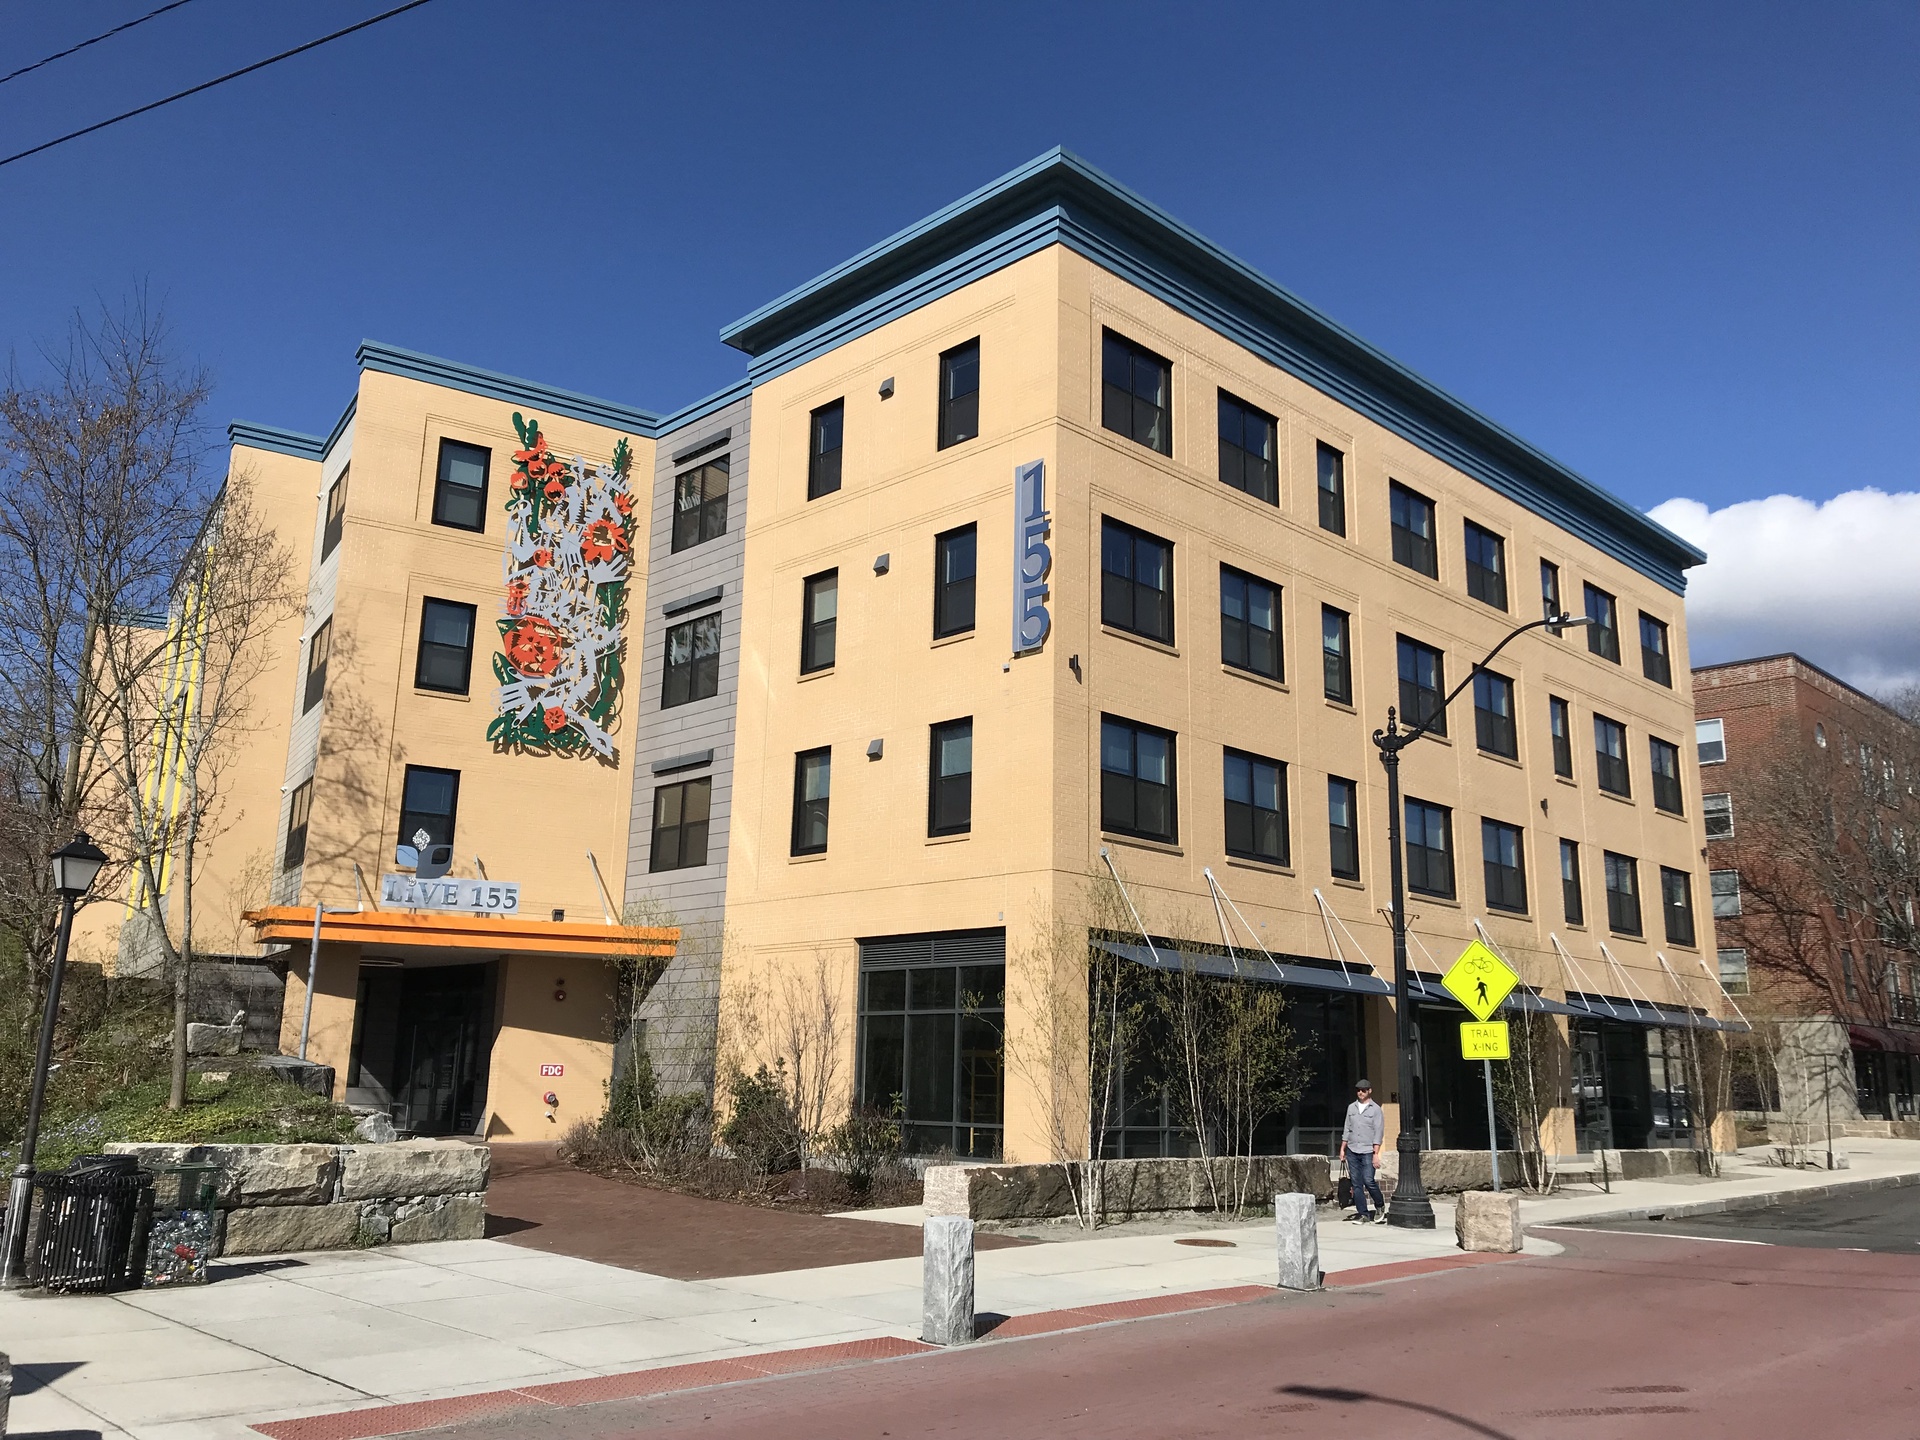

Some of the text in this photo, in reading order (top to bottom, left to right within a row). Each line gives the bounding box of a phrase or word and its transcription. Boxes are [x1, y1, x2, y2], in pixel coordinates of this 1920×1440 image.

[1021, 461, 1051, 646] 155
[470, 886, 518, 909] 155
[1471, 1029, 1498, 1038] TRAIL
[1473, 1042, 1499, 1051] X-ING
[542, 1065, 562, 1076] FDC
